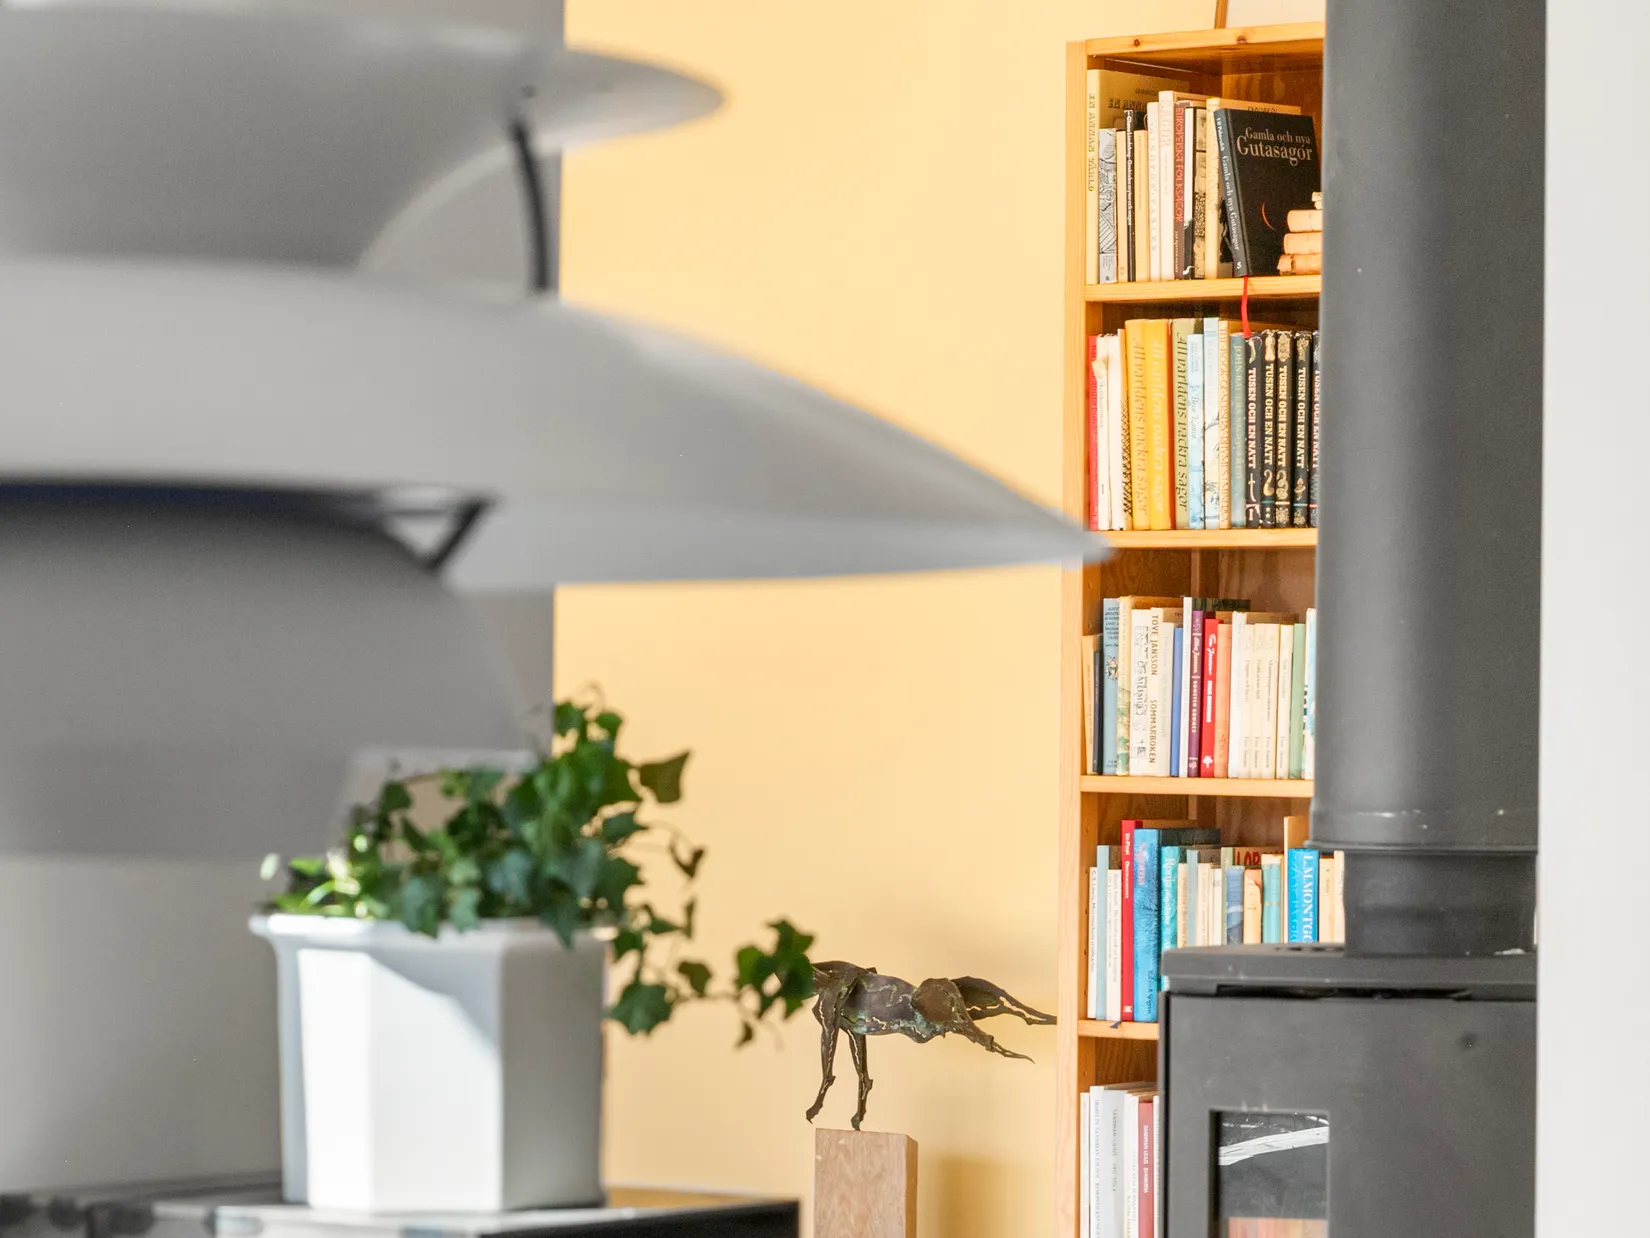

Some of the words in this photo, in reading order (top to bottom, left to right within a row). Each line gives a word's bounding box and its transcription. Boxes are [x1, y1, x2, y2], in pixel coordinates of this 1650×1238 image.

[1176, 107, 1184, 162] EUROPEISKA
[1245, 126, 1275, 141] Gamla
[1276, 131, 1293, 143] och
[1295, 135, 1311, 147] nya
[1236, 135, 1313, 167] Gutasagor
[1222, 155, 1231, 181] Gamla
[1176, 164, 1184, 222] FOLKSAGOR
[1225, 182, 1233, 197] och
[1226, 198, 1234, 212] nya
[1230, 212, 1241, 251] Gutasagor
[1132, 338, 1145, 361] All
[1177, 332, 1188, 358] All
[1234, 345, 1243, 373] JOHN
[1220, 348, 1229, 376] BOOK
[1176, 358, 1188, 417] världens
[1248, 367, 1257, 401] TUSEN
[1264, 363, 1273, 398] TUSEN
[1278, 365, 1287, 400] TUSEN
[1296, 366, 1306, 401] TUSEN
[1248, 403, 1257, 425] OCH
[1264, 399, 1273, 421] OCH
[1278, 401, 1287, 422] OCH
[1296, 402, 1306, 424] OCH
[1248, 426, 1257, 438] EN
[1264, 422, 1273, 435] EN
[1278, 423, 1287, 437] EN
[1296, 424, 1306, 438] EN
[1136, 426, 1149, 472] vackra
[1152, 424, 1167, 470] vackra
[1178, 421, 1189, 468] vackra
[1220, 436, 1229, 476] RHYMES
[1248, 439, 1257, 469] NATT
[1264, 436, 1273, 466] NATT
[1278, 438, 1287, 467] NATT
[1296, 439, 1306, 469] NATT
[1137, 475, 1149, 515] sagor
[1152, 473, 1164, 515] sagor
[1176, 472, 1188, 512] sagor
[1150, 640, 1158, 676] JANSSON
[1149, 699, 1158, 764] SOMMARBOKEN
